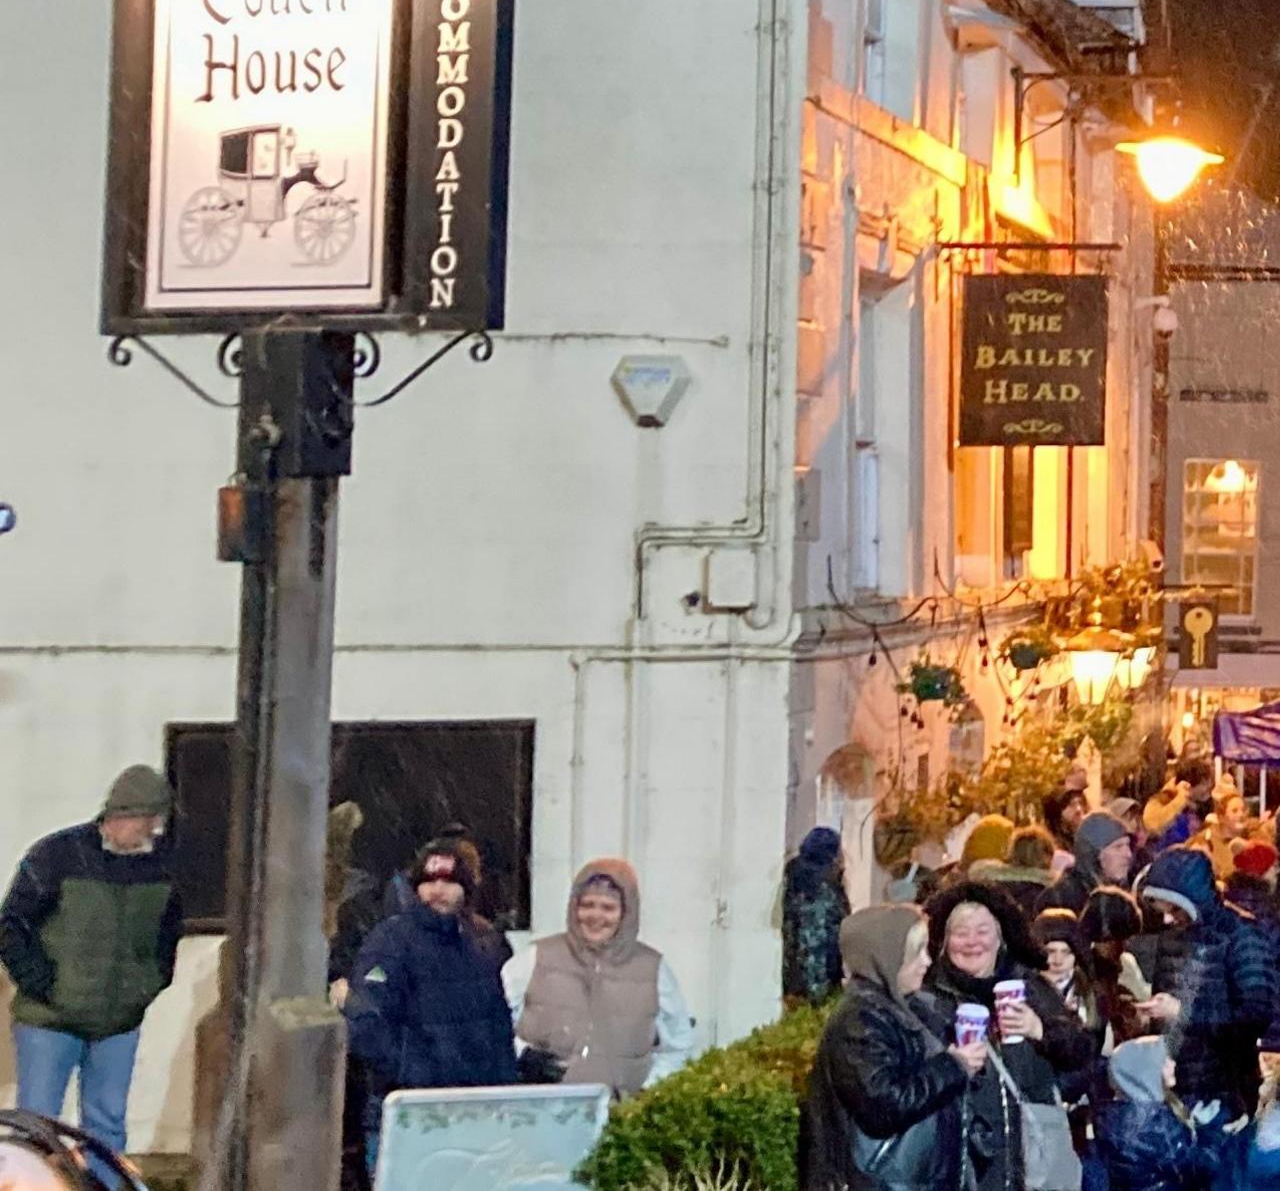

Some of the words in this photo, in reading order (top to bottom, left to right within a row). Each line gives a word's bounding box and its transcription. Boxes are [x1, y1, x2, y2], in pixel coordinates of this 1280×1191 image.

[194, 33, 346, 102] House
[1007, 312, 1063, 336] THE
[974, 345, 1094, 369] BAILEY
